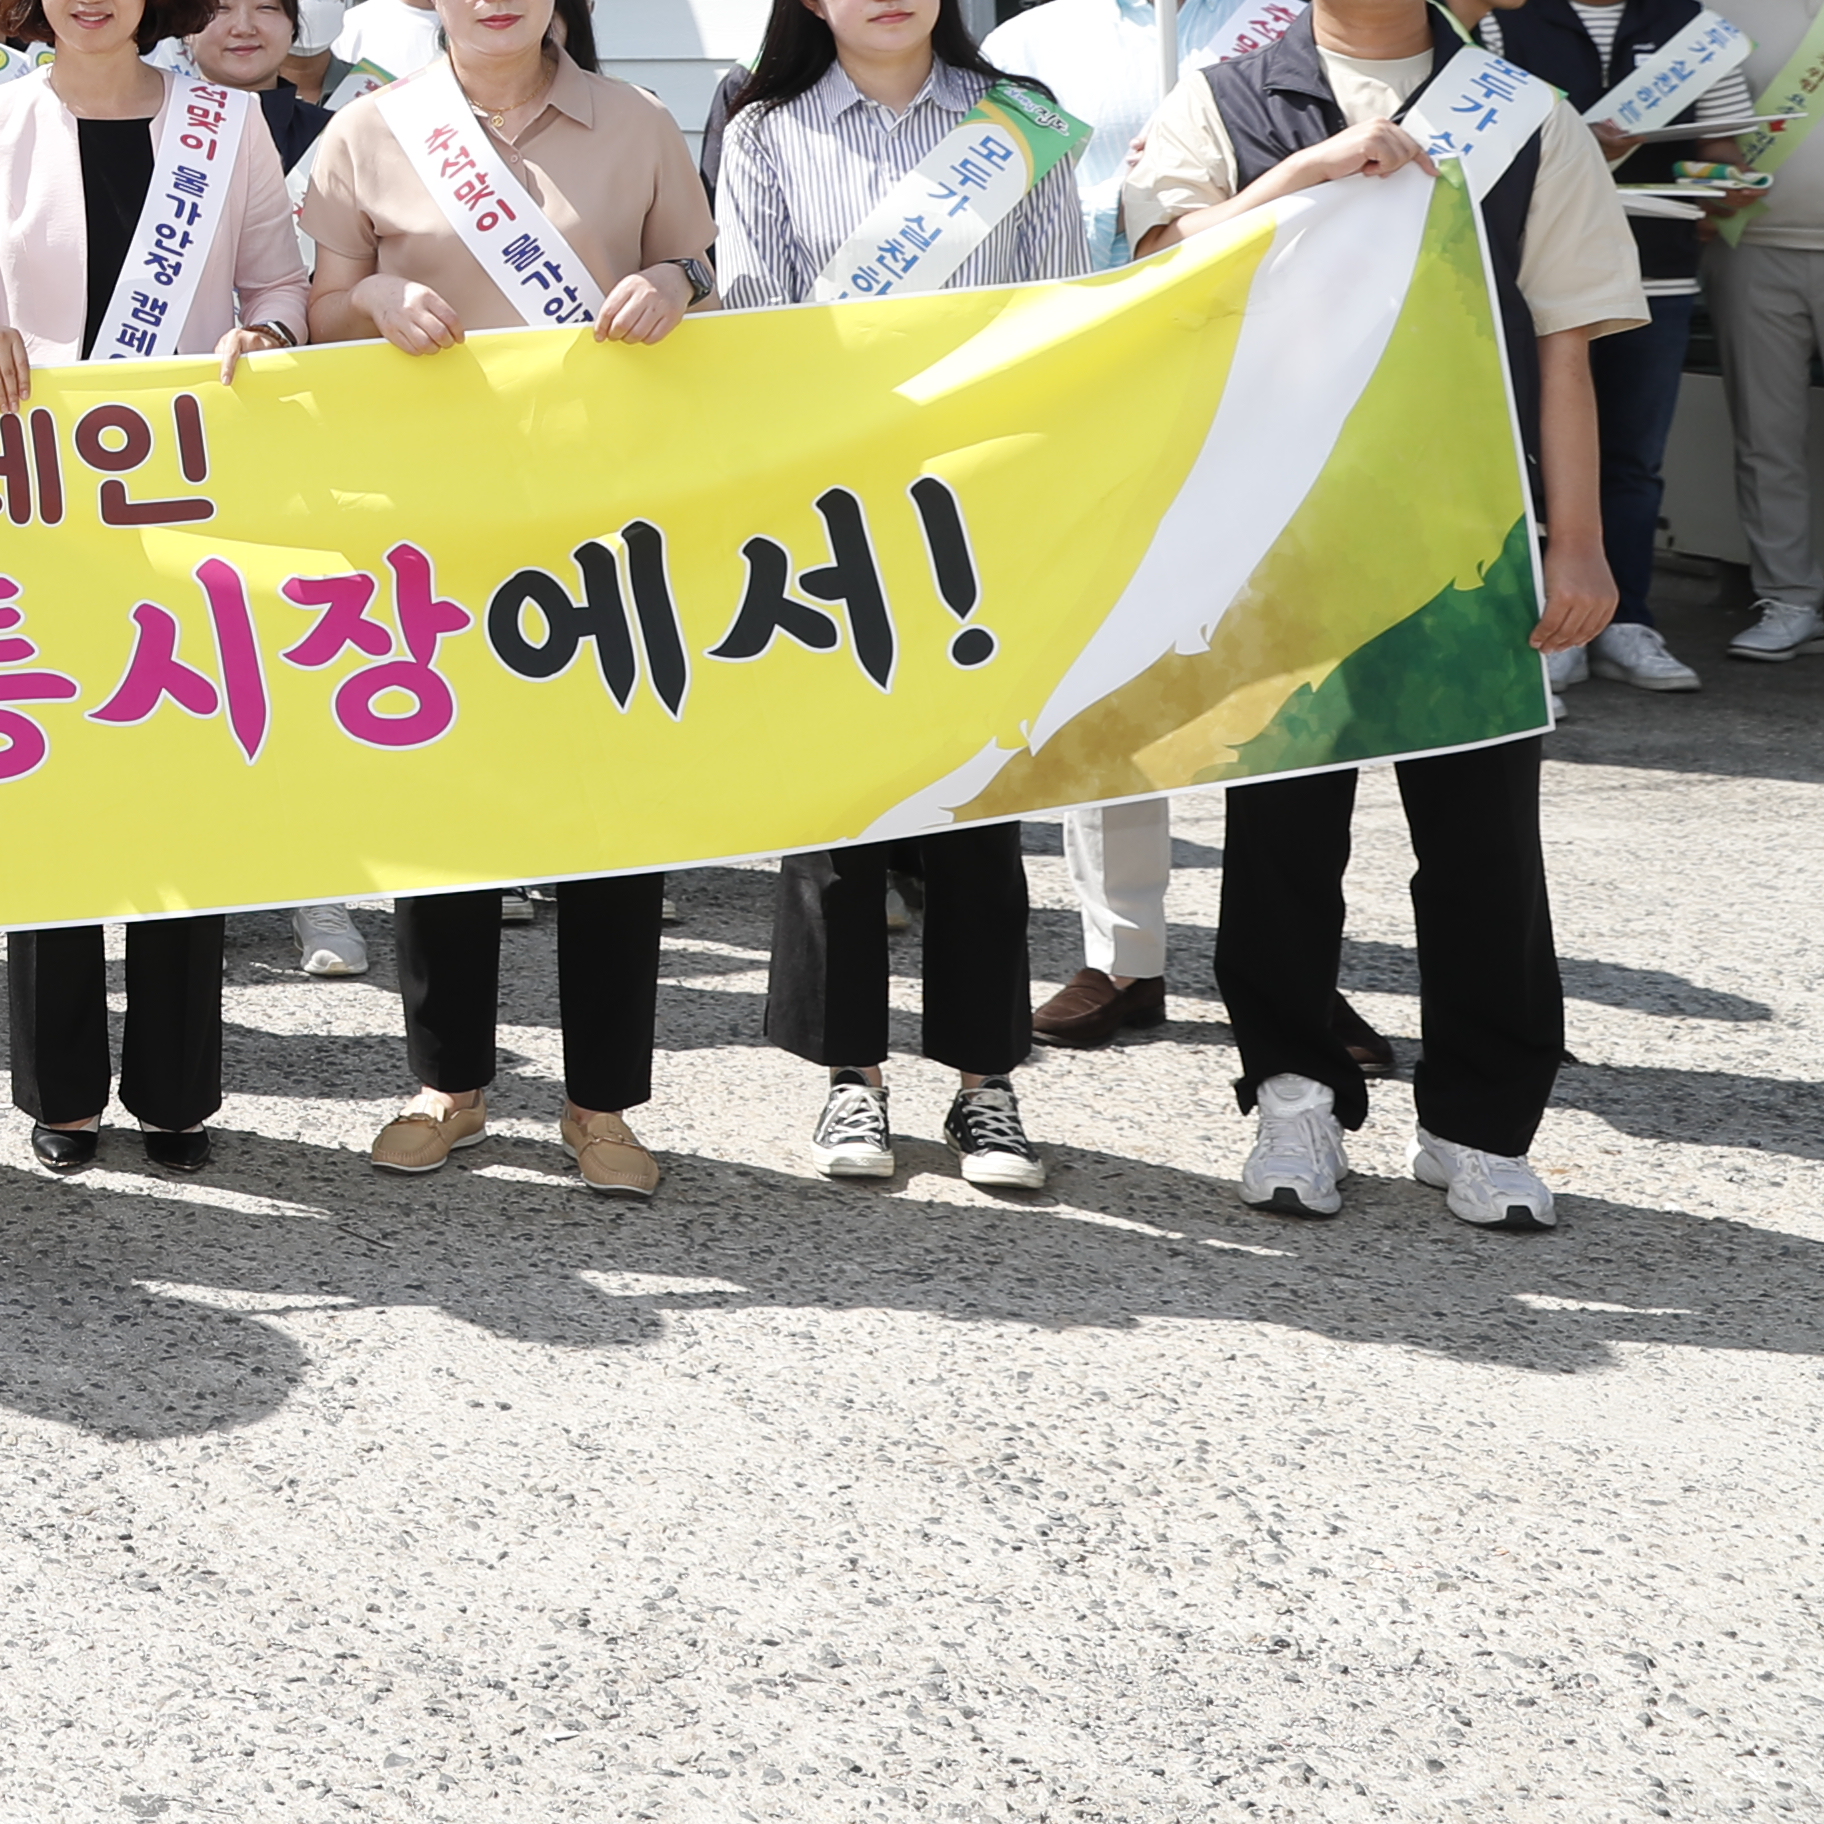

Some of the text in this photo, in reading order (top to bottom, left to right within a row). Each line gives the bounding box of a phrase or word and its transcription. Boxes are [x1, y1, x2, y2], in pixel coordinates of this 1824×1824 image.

[179, 79, 228, 162] 석맞이
[144, 164, 209, 287] 물가안정
[424, 122, 518, 234] 추석맞이
[833, 132, 1016, 300] 모두가 실천하
[107, 290, 170, 360] 캠페
